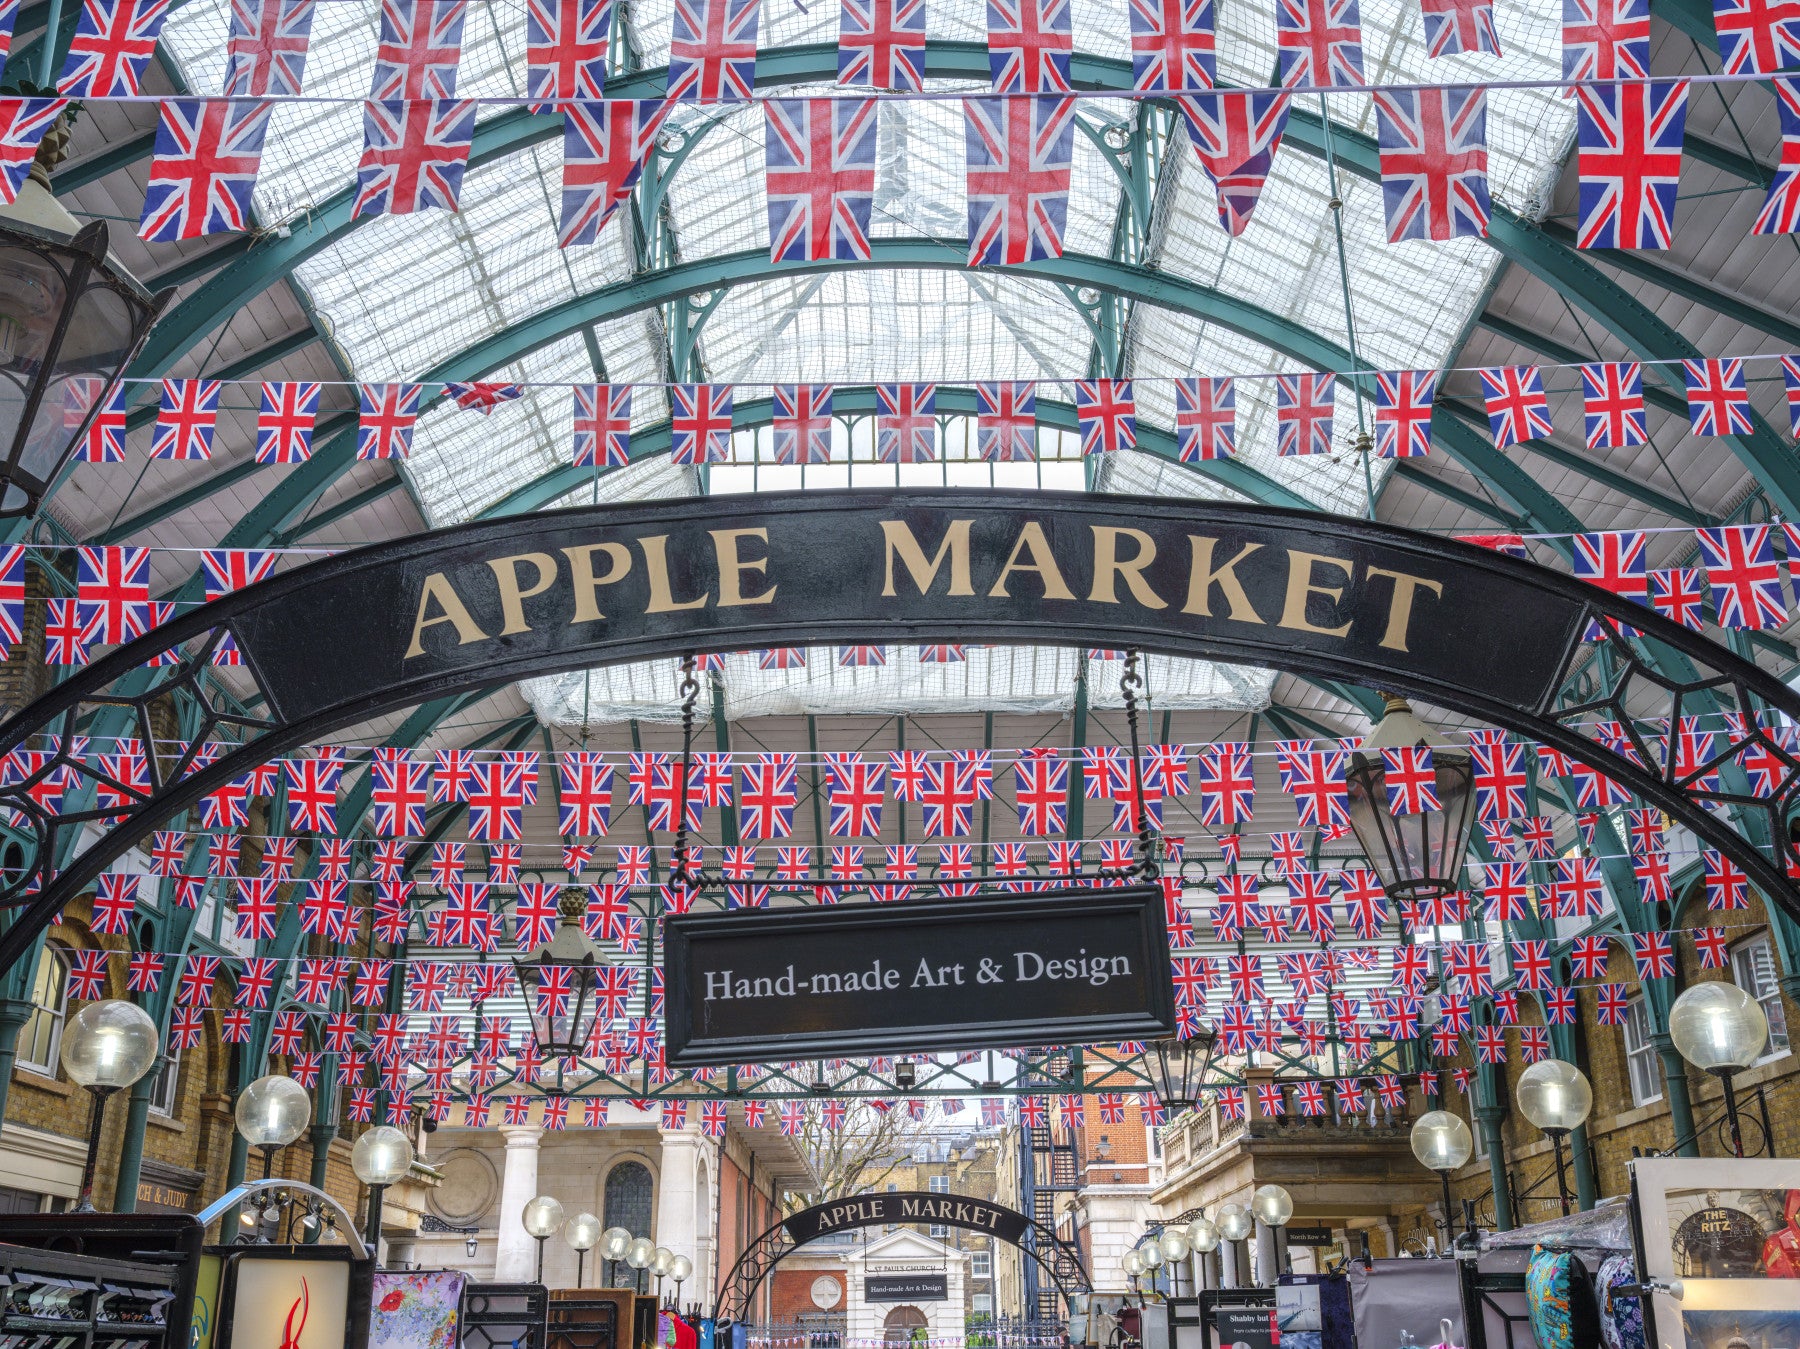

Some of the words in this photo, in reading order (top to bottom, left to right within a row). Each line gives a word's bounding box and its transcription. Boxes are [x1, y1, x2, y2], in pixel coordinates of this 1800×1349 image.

[403, 527, 778, 659] APPLE
[879, 519, 1444, 653] MARKET
[703, 960, 900, 1001] Hand-made
[910, 957, 965, 988] Art
[976, 957, 1004, 983] &
[1013, 949, 1132, 985] Design
[137, 1183, 152, 1202] CH
[154, 1187, 161, 1204] &
[163, 1189, 188, 1208] JUDY
[818, 1200, 884, 1230] APPLE
[902, 1199, 1002, 1229] MARKET
[1704, 1210, 1726, 1220] THE
[1701, 1221, 1731, 1232] RITZ
[922, 1284, 942, 1292] Design
[1230, 1315, 1255, 1323] Shabby
